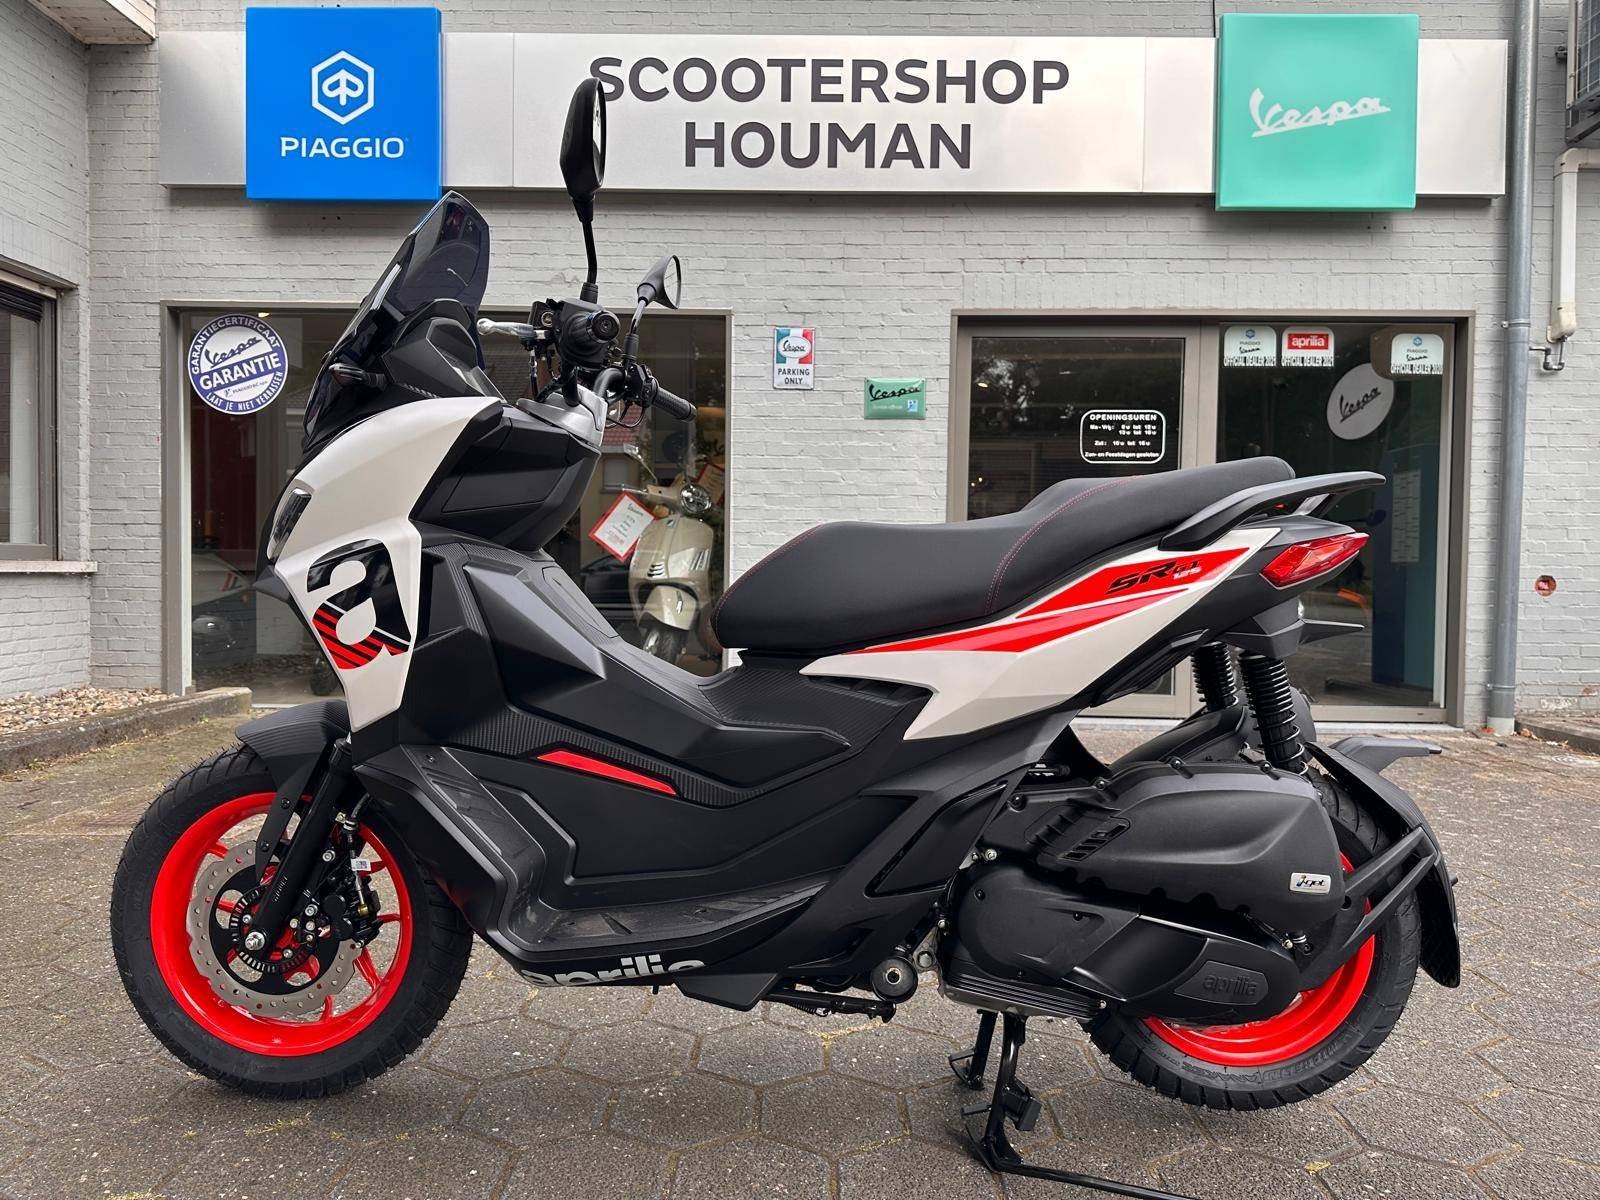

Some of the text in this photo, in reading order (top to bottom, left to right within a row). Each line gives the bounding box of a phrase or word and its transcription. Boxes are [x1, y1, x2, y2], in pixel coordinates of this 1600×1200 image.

[590, 57, 1070, 104] SCOOTERSHOP
[1249, 88, 1391, 137] Vespa
[280, 137, 405, 158] PIAGGIO
[685, 121, 971, 169] HOUMAN
[191, 317, 280, 375] GARANTIECERTIFICAAT
[783, 340, 806, 352] Vespa
[1292, 335, 1325, 348] aprilia
[204, 336, 263, 369] Vespa
[1246, 356, 1263, 366] DEALER
[1303, 356, 1320, 366] DEALER
[199, 353, 282, 390] GARANTIE
[778, 368, 810, 376] PARKING
[1412, 364, 1429, 374] DEALER
[784, 377, 803, 385] ONLY
[206, 392, 222, 407] LAAT
[225, 401, 233, 411] JE
[238, 400, 255, 411] NIET
[869, 384, 922, 402] Vespa
[1340, 387, 1381, 422] Vespa
[1105, 561, 1177, 595] SR
[1202, 974, 1258, 995] aprilia
